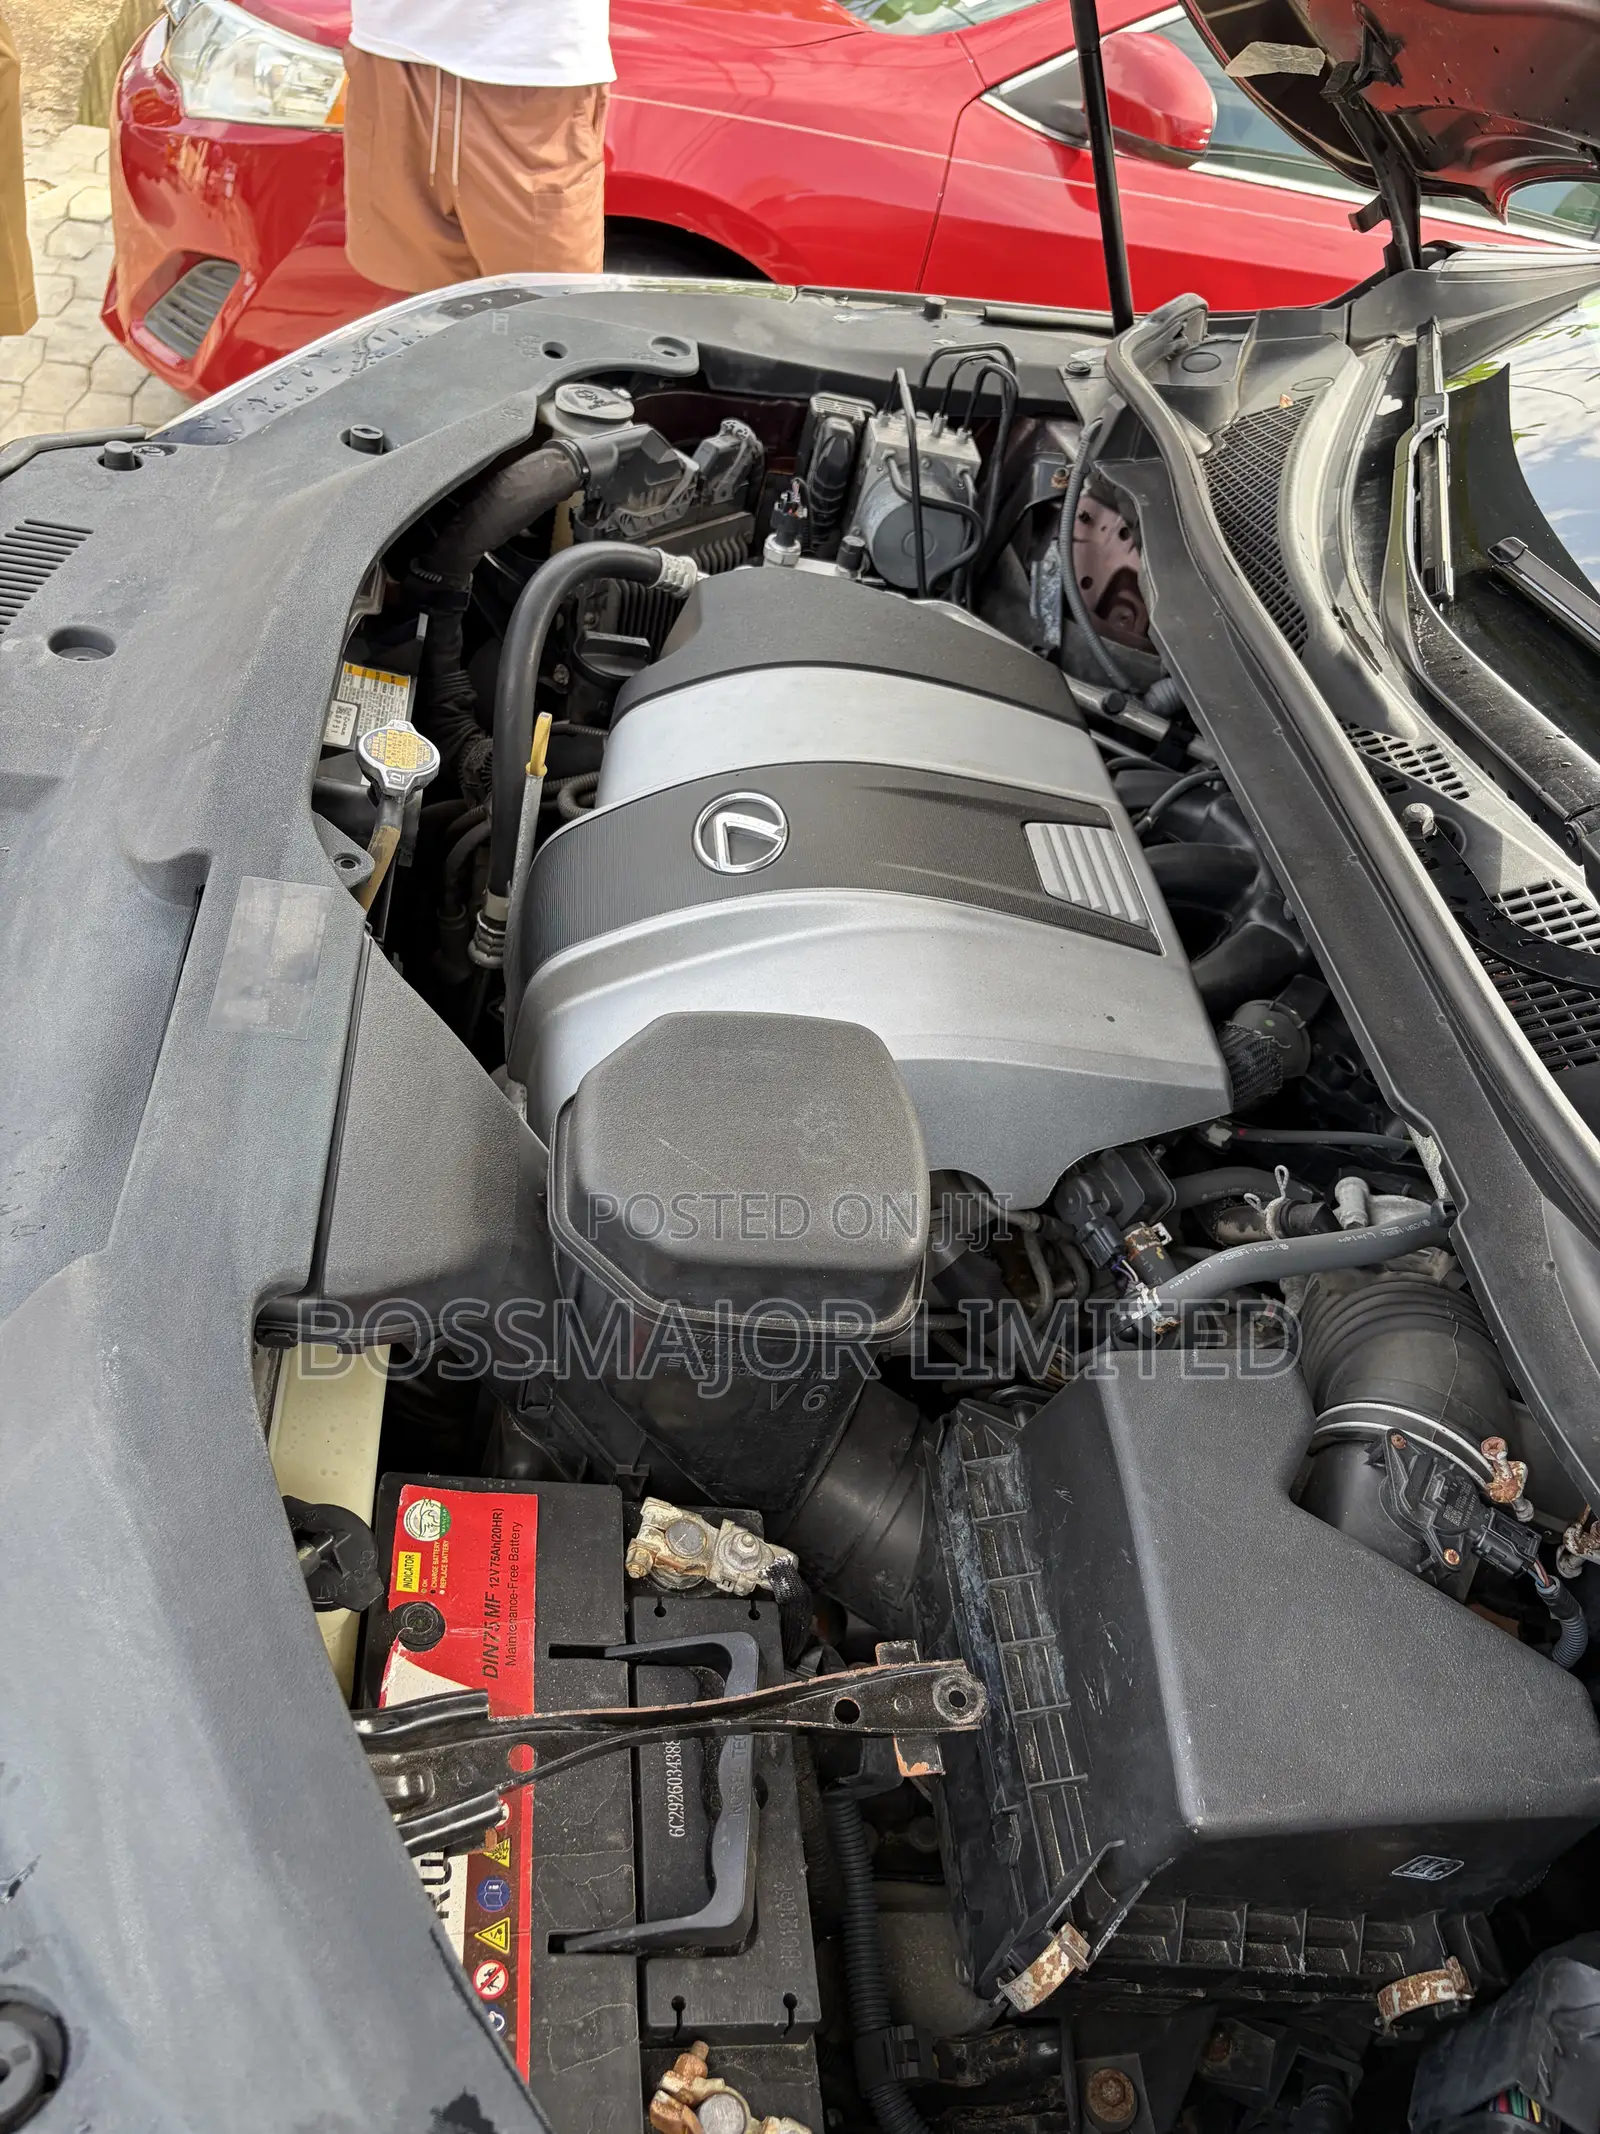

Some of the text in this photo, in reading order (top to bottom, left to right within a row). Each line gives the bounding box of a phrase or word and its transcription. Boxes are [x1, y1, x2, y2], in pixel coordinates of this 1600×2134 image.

[402, 1554, 415, 1590] INDICATOR
[422, 1578, 428, 1588] OK
[431, 1541, 440, 1588] CHARGE BATTERY
[440, 1540, 449, 1589] REPLACE BATTERY
[481, 1508, 505, 1679] DIN75 MF 12V 75Ah(20HR)
[505, 1522, 524, 1667] Maintenance-Free Battery
